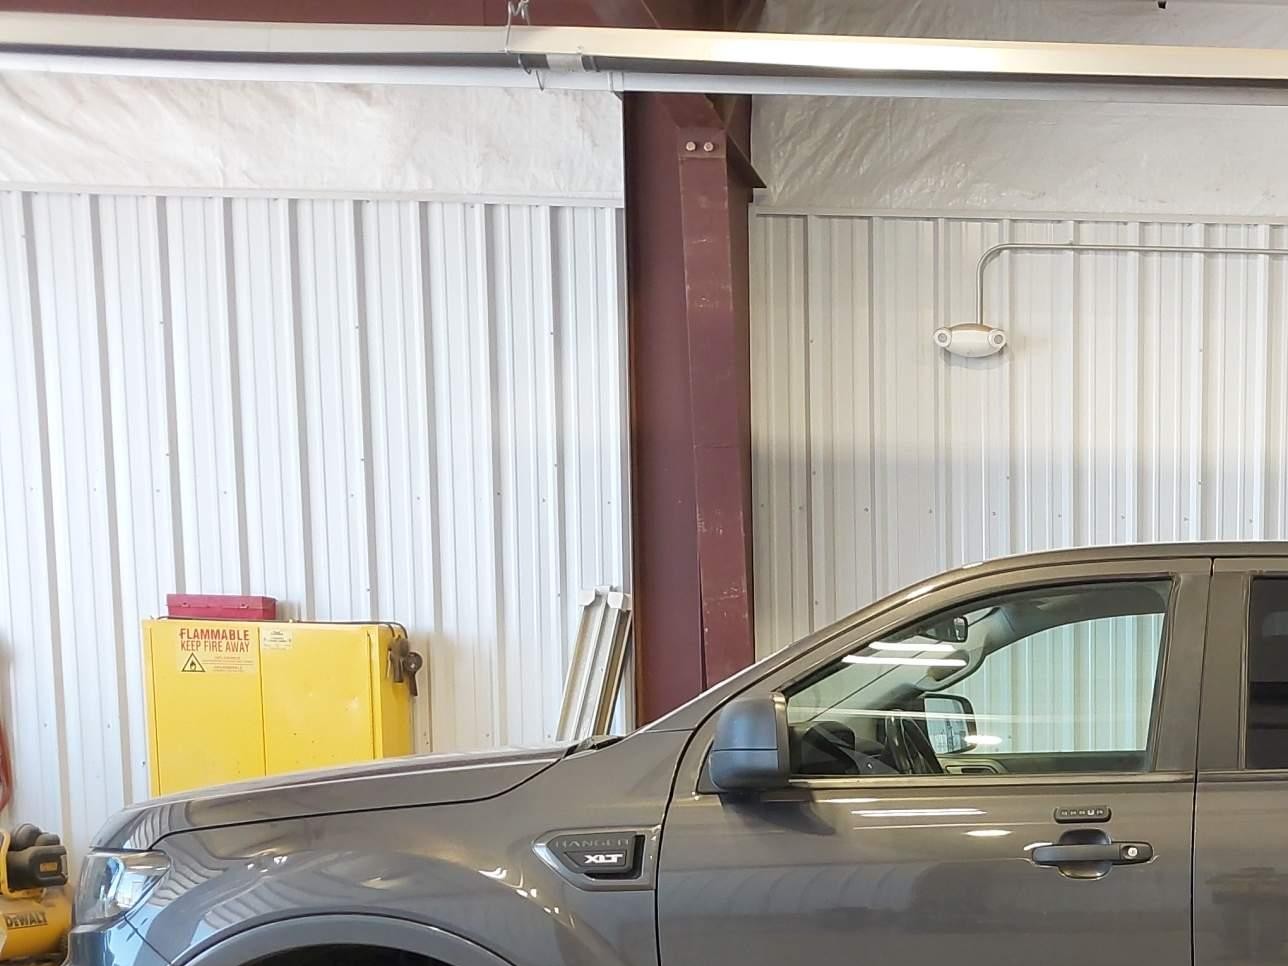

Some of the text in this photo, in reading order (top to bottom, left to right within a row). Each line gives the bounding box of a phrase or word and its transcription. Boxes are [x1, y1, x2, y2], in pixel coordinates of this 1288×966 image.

[180, 628, 250, 641] FLAMMABLE
[180, 640, 250, 653] KEEP FIRE AWAY
[584, 854, 624, 864] XLT
